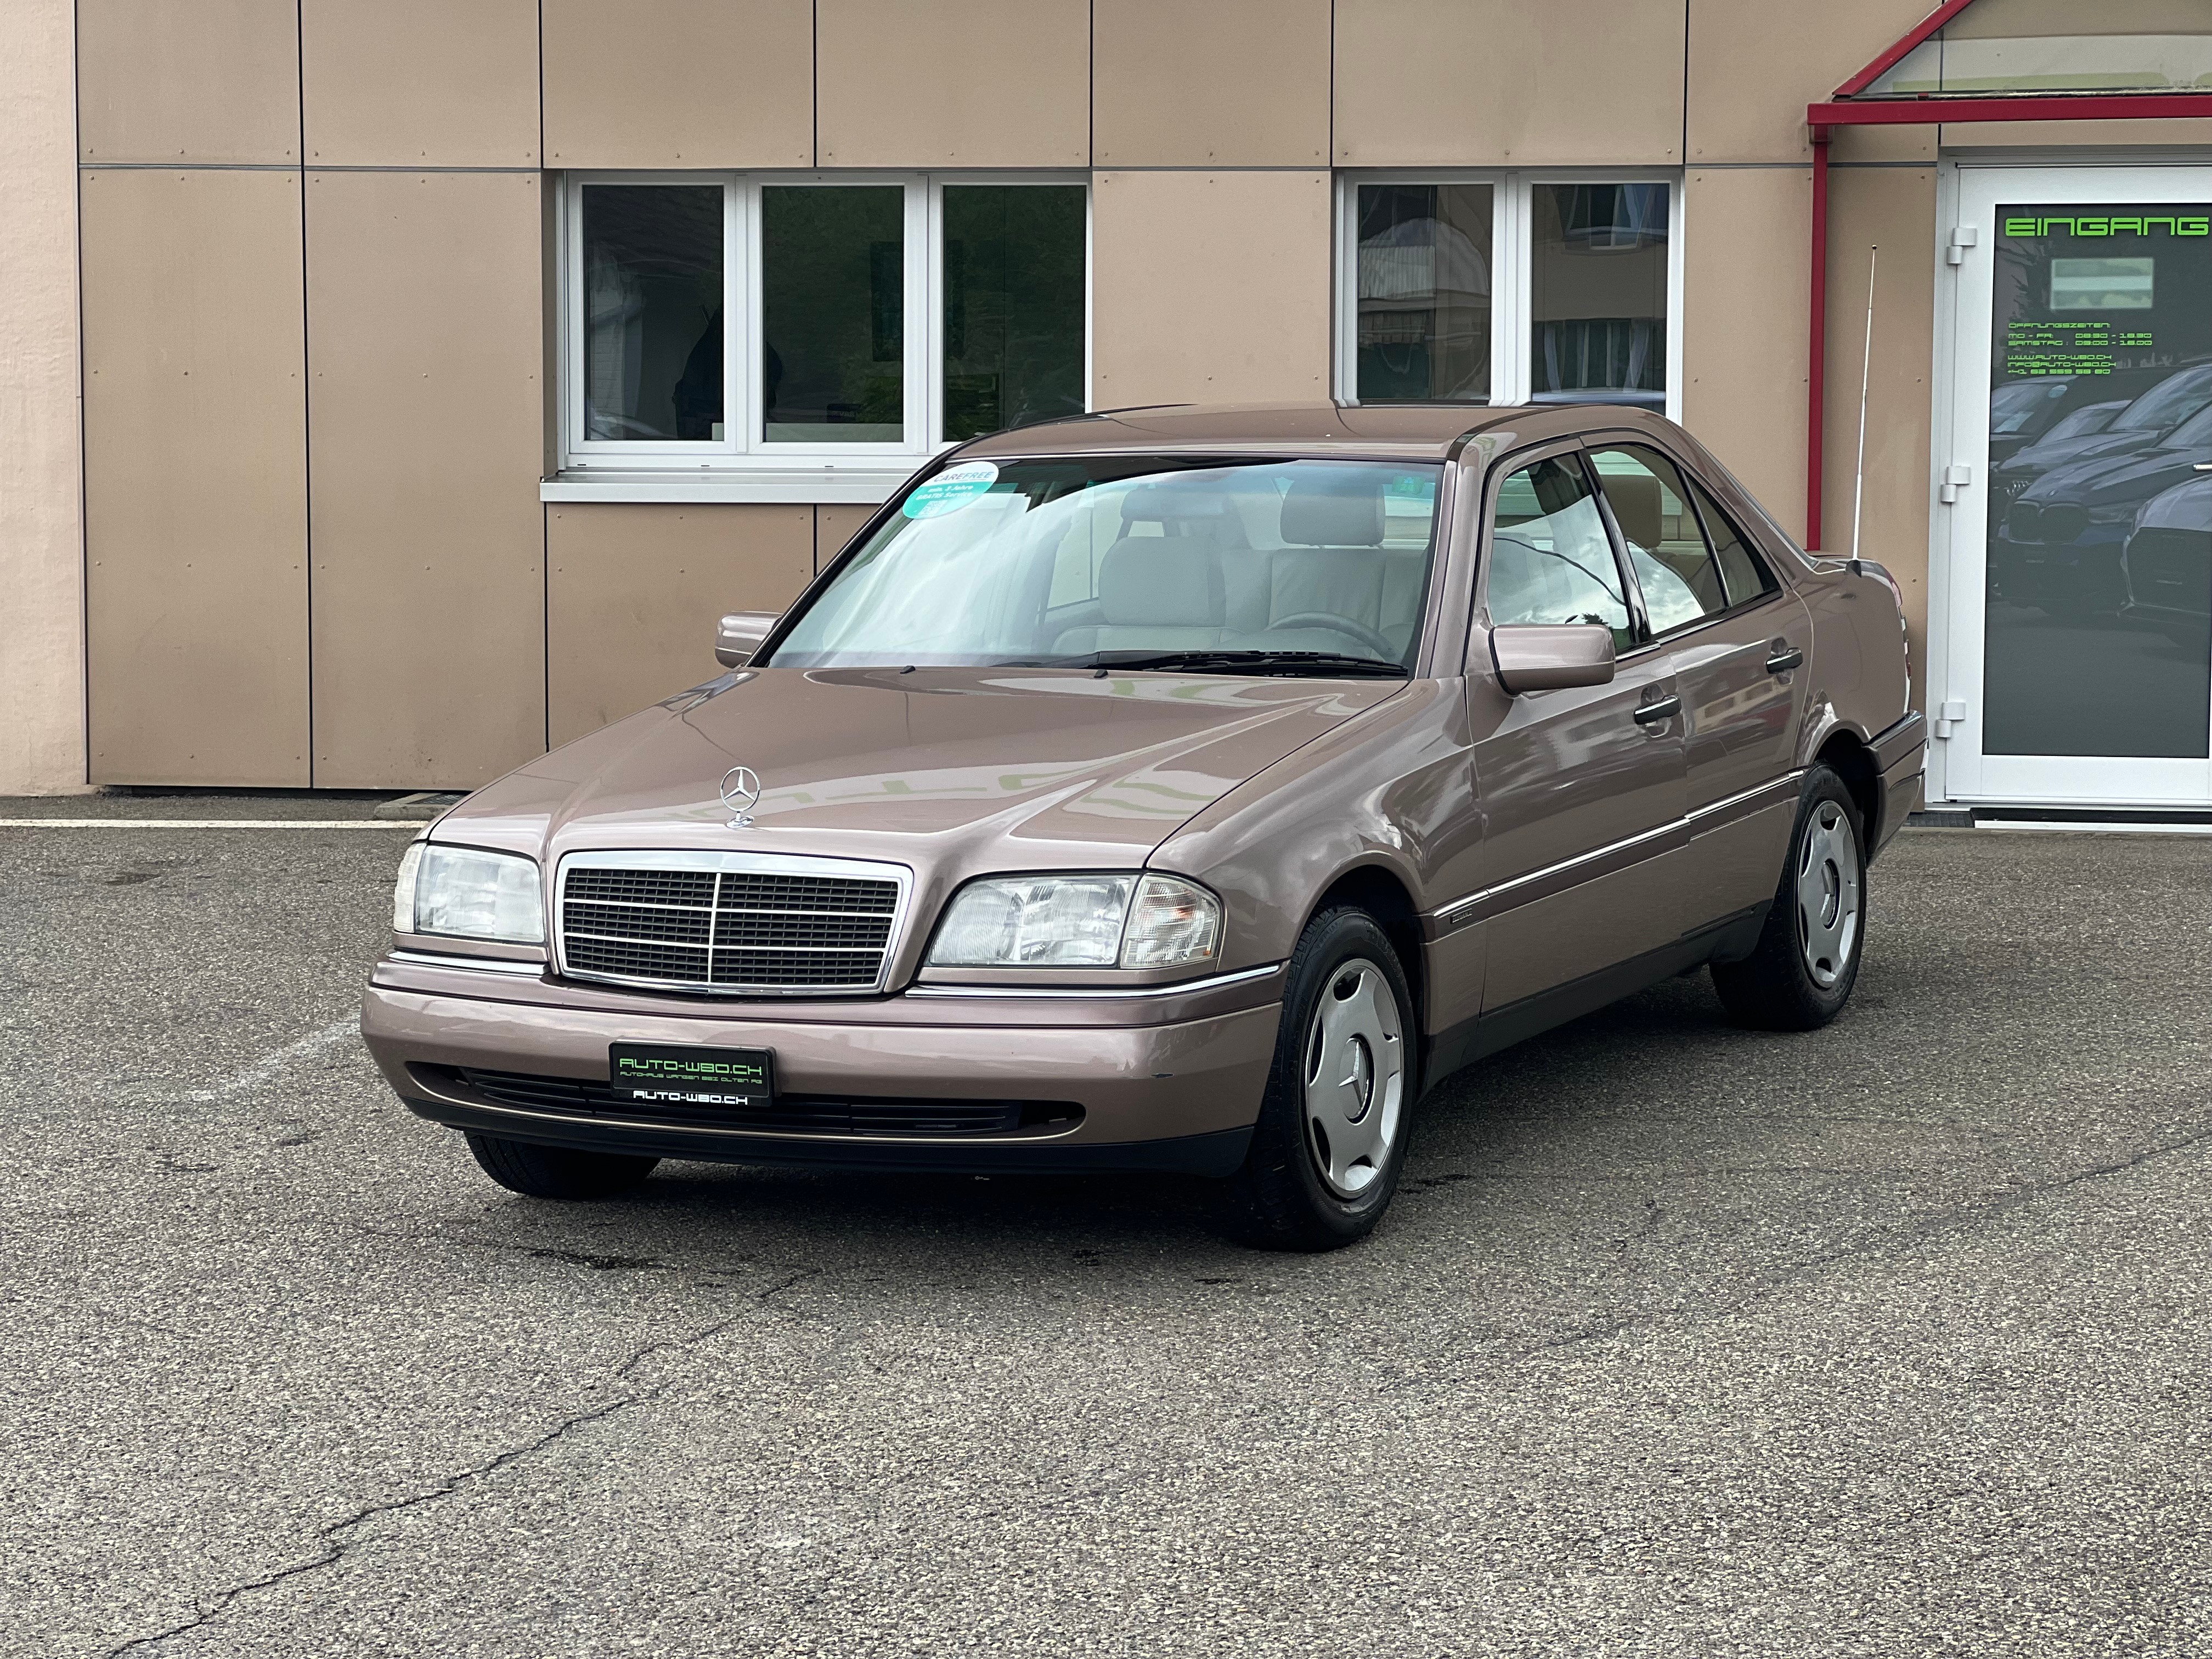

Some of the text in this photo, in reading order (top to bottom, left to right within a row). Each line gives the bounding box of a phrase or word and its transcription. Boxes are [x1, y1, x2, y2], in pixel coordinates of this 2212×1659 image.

[2006, 217, 2209, 236] EINGANG
[934, 471, 995, 482] CAREFREE
[915, 492, 944, 500] GRATIS
[619, 1058, 762, 1076] AUTO-WBO.CH
[633, 1090, 748, 1105] AUTO-WBO.CH
